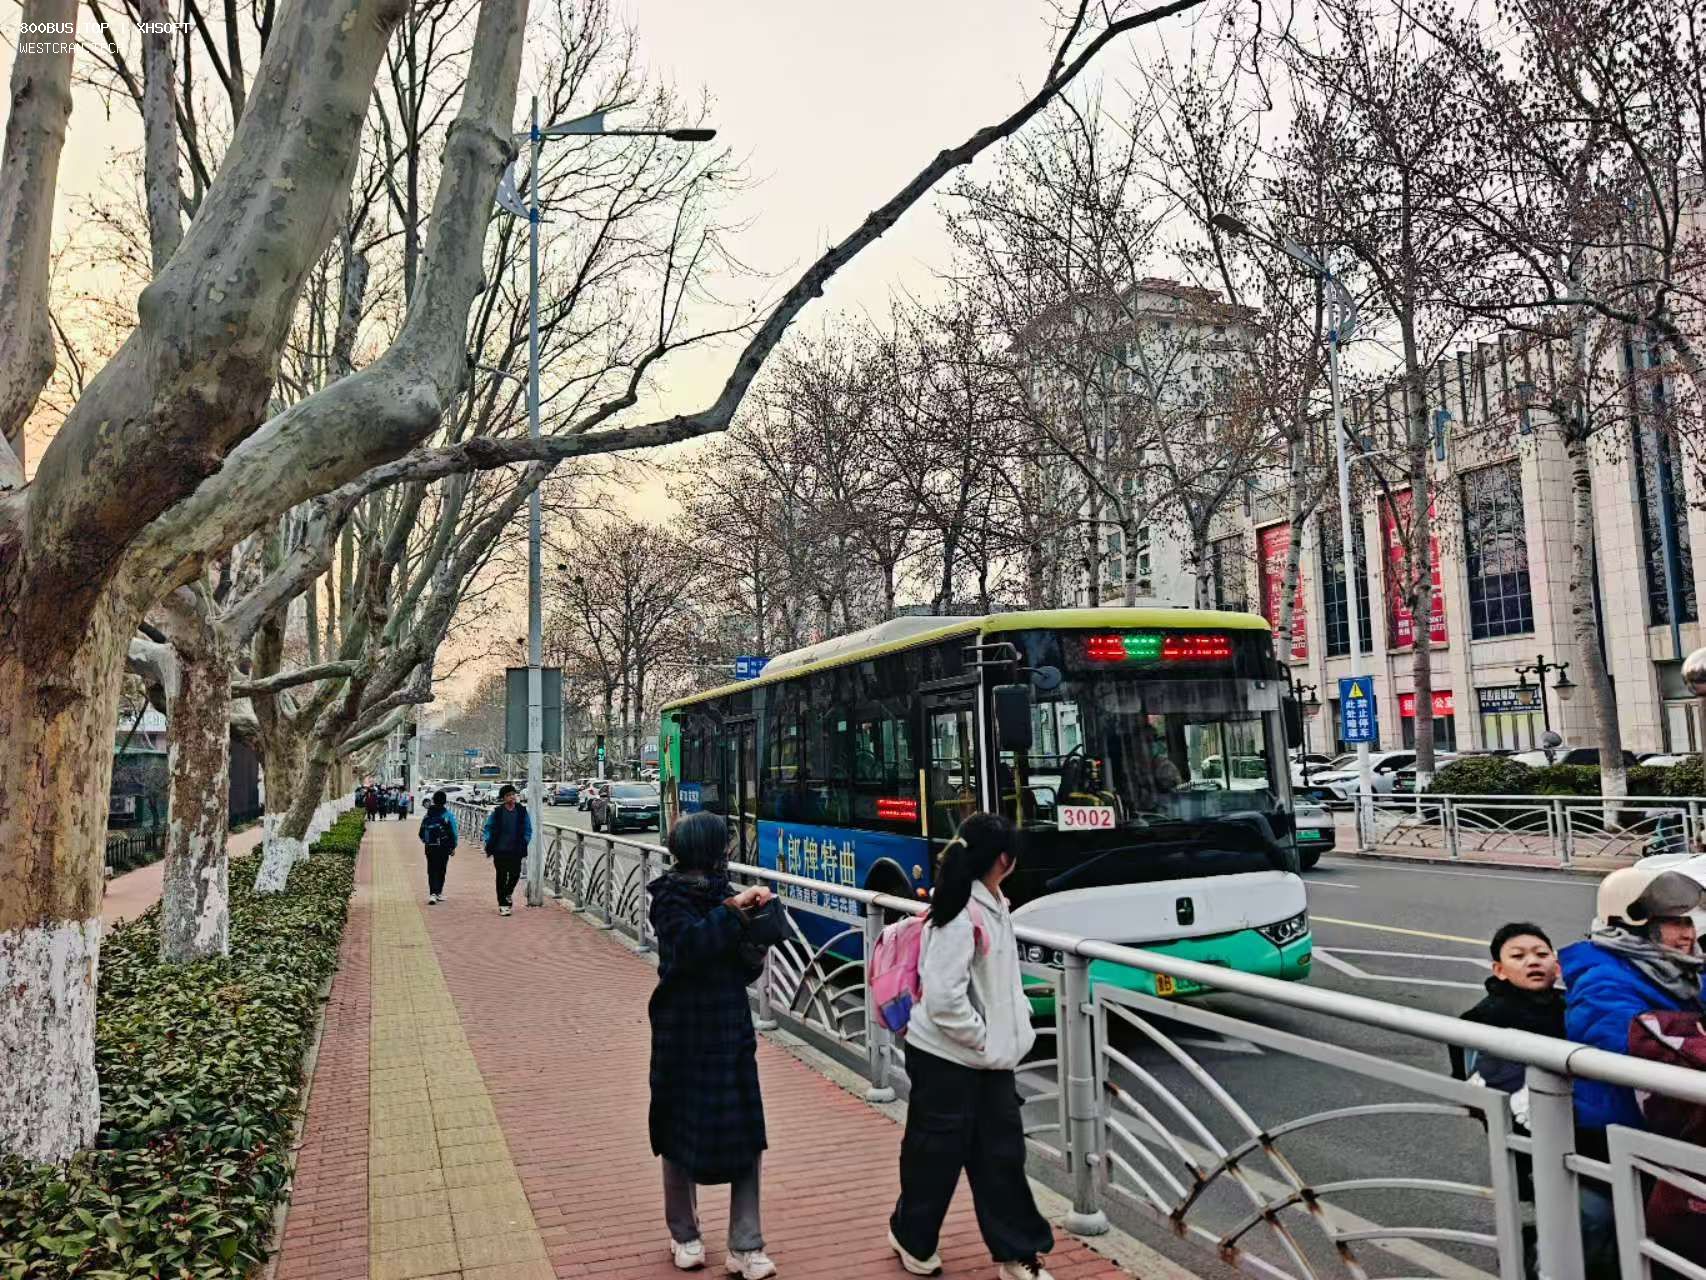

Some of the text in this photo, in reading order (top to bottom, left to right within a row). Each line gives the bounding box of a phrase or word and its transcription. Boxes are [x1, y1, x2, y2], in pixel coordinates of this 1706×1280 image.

[1356, 699, 1370, 738] 禁止停车
[1063, 808, 1112, 827] 3002
[787, 832, 856, 888] 郎牌特曲
